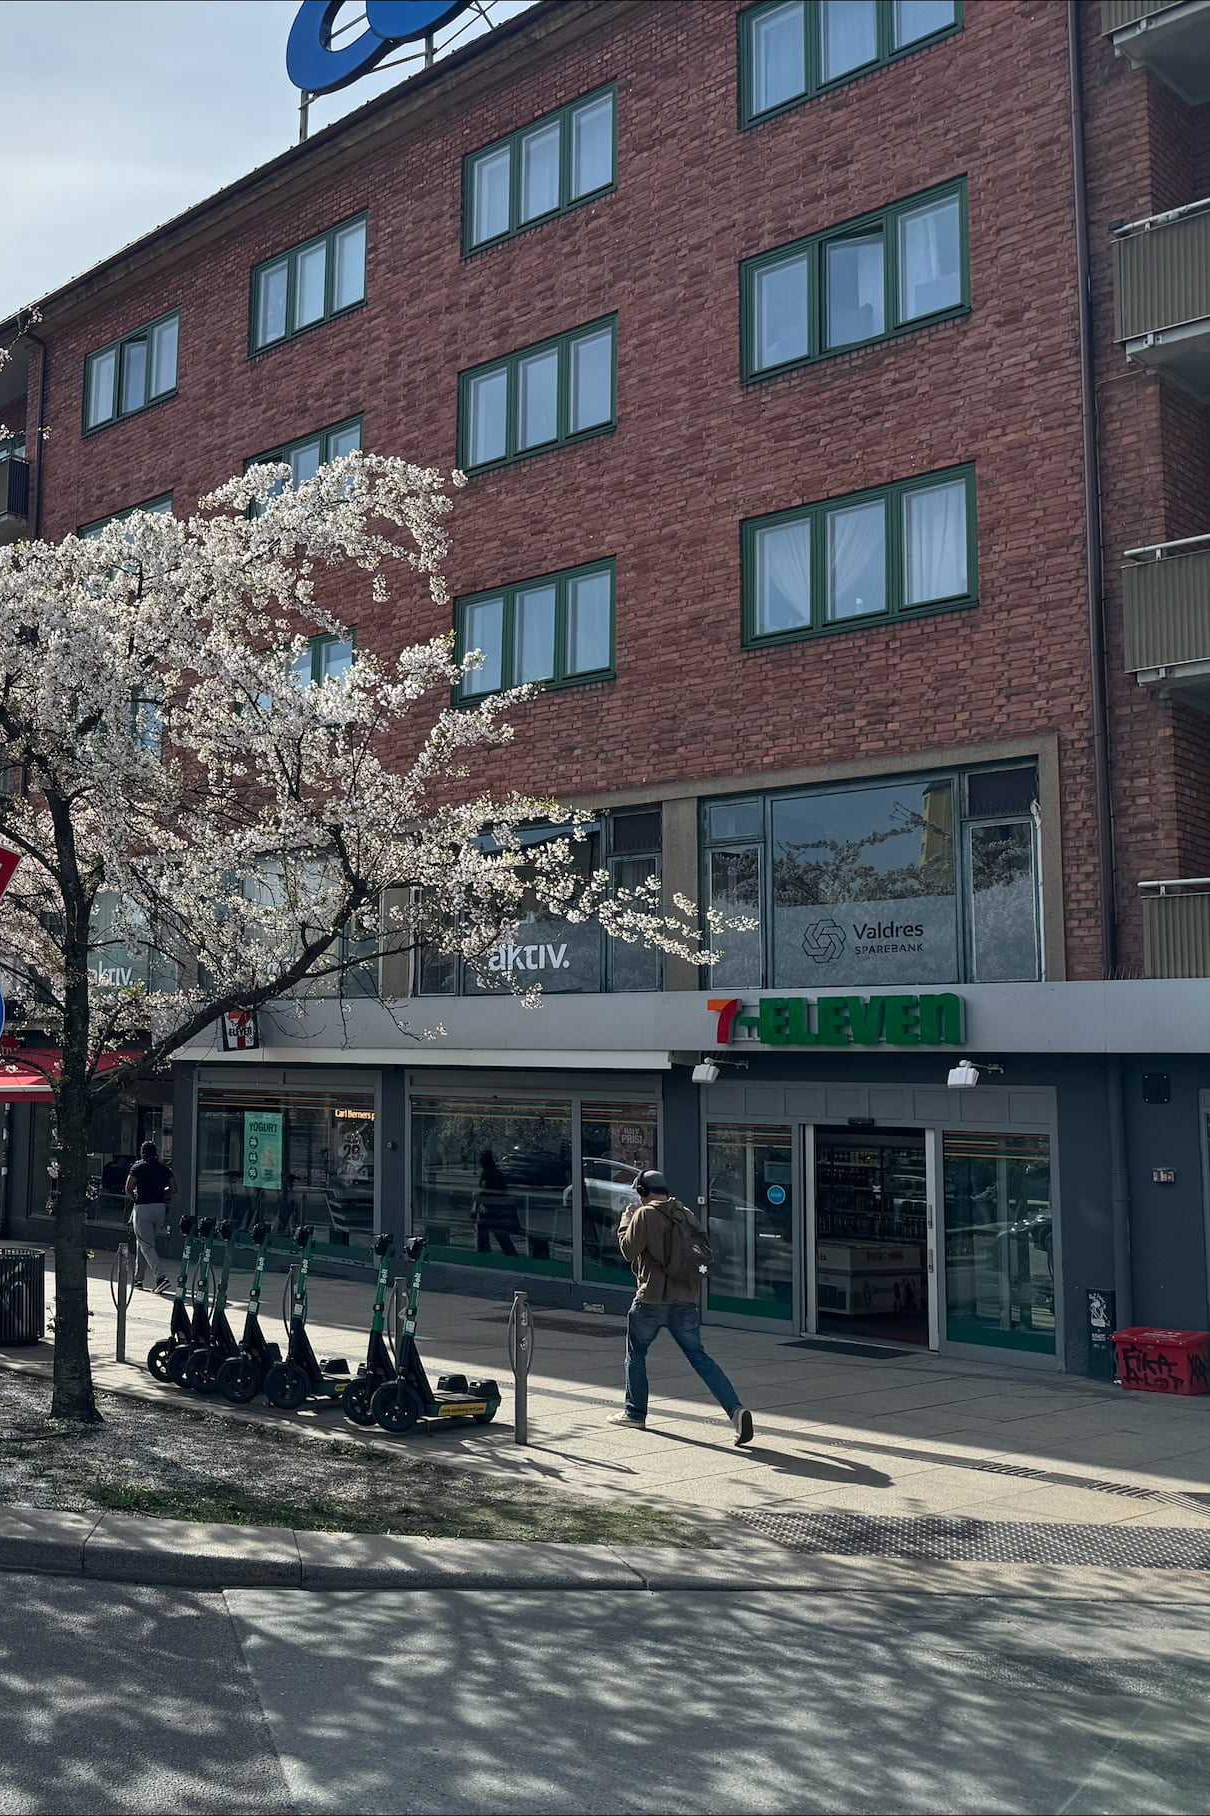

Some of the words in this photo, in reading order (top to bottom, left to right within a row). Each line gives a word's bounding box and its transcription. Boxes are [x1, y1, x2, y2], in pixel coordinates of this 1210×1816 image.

[853, 921, 924, 940] Valdres
[855, 943, 924, 955] SPAREBANK
[707, 993, 963, 1045] 7-ELEVEN
[335, 1109, 347, 1118] Carl
[249, 1122, 278, 1133] YOGURT
[624, 1127, 640, 1135] HALV
[621, 1134, 643, 1144] PRIS!
[203, 1248, 212, 1262] Bolt
[257, 1256, 265, 1271] Bolt
[301, 1259, 309, 1274] Bolt
[380, 1268, 388, 1284] Bolt
[413, 1272, 421, 1288] Bolt
